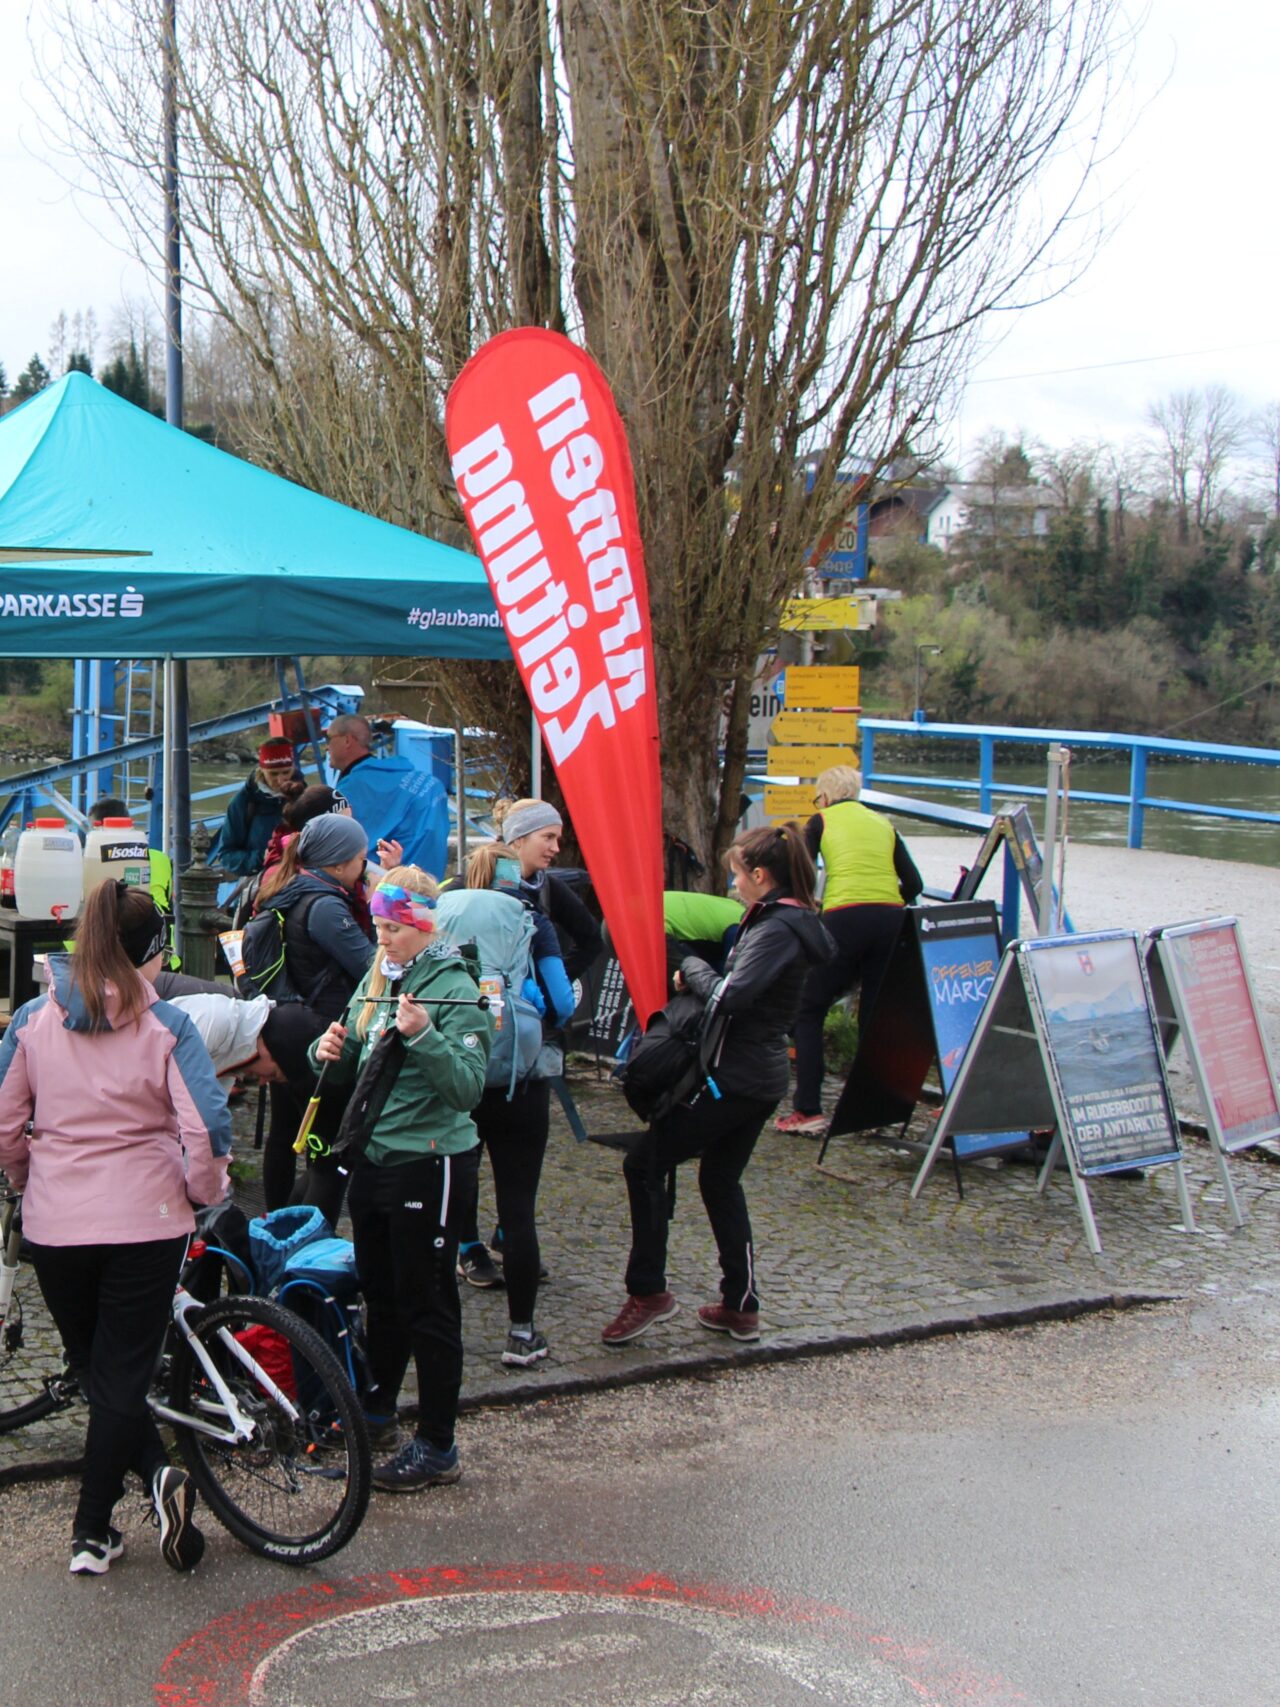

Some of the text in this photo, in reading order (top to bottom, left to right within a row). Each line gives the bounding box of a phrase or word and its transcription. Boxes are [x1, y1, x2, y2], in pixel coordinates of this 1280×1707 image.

[838, 531, 854, 549] 20
[112, 845, 148, 858] isostar
[932, 960, 996, 983] OFFENER
[1071, 1095, 1163, 1122] IM RUDERBOOT IN
[1077, 1124, 1102, 1142] DER
[1103, 1113, 1167, 1138] ANTARKTIS
[264, 1542, 301, 1556] RACING
